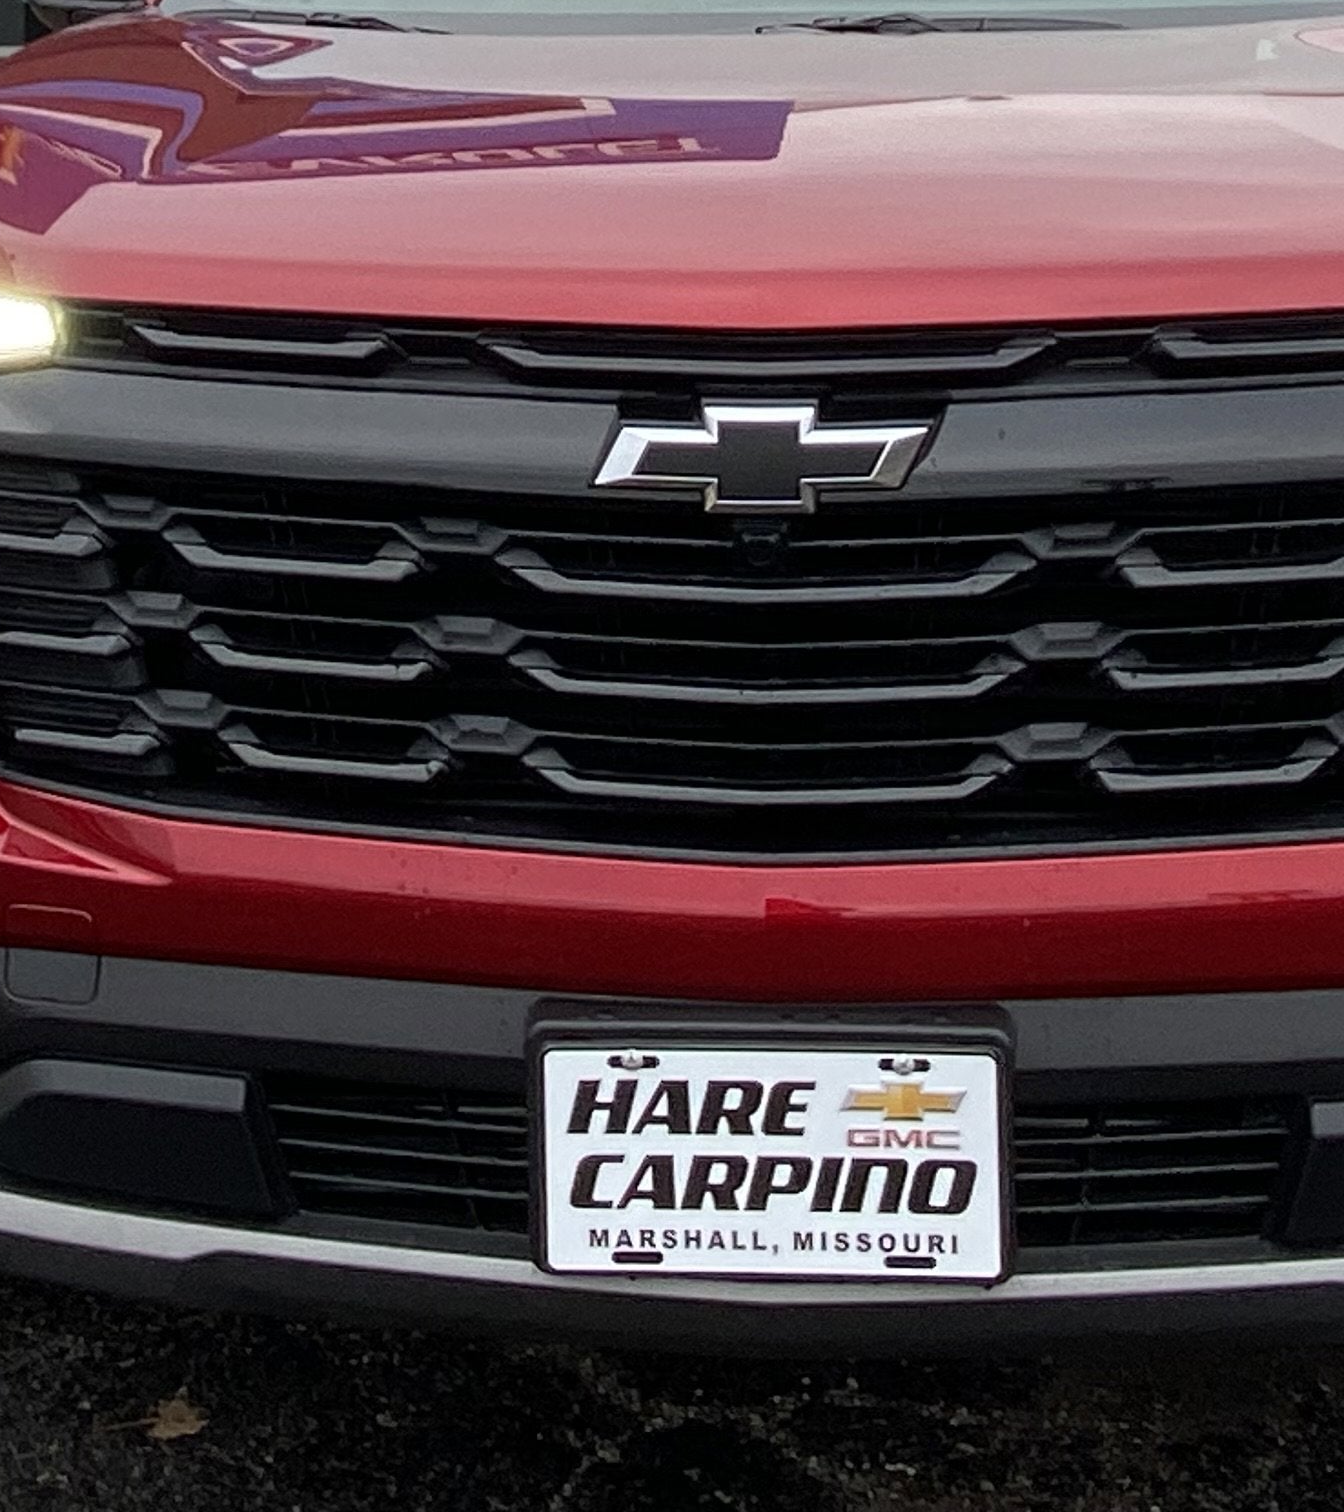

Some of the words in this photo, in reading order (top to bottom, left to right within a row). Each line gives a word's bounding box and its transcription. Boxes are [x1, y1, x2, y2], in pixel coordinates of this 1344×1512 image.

[567, 1079, 817, 1136] HARE
[846, 1129, 961, 1150] GMC
[570, 1155, 978, 1215] CARPINO
[589, 1229, 779, 1255] MARSHALL,
[793, 1231, 959, 1254] MISSOURI
